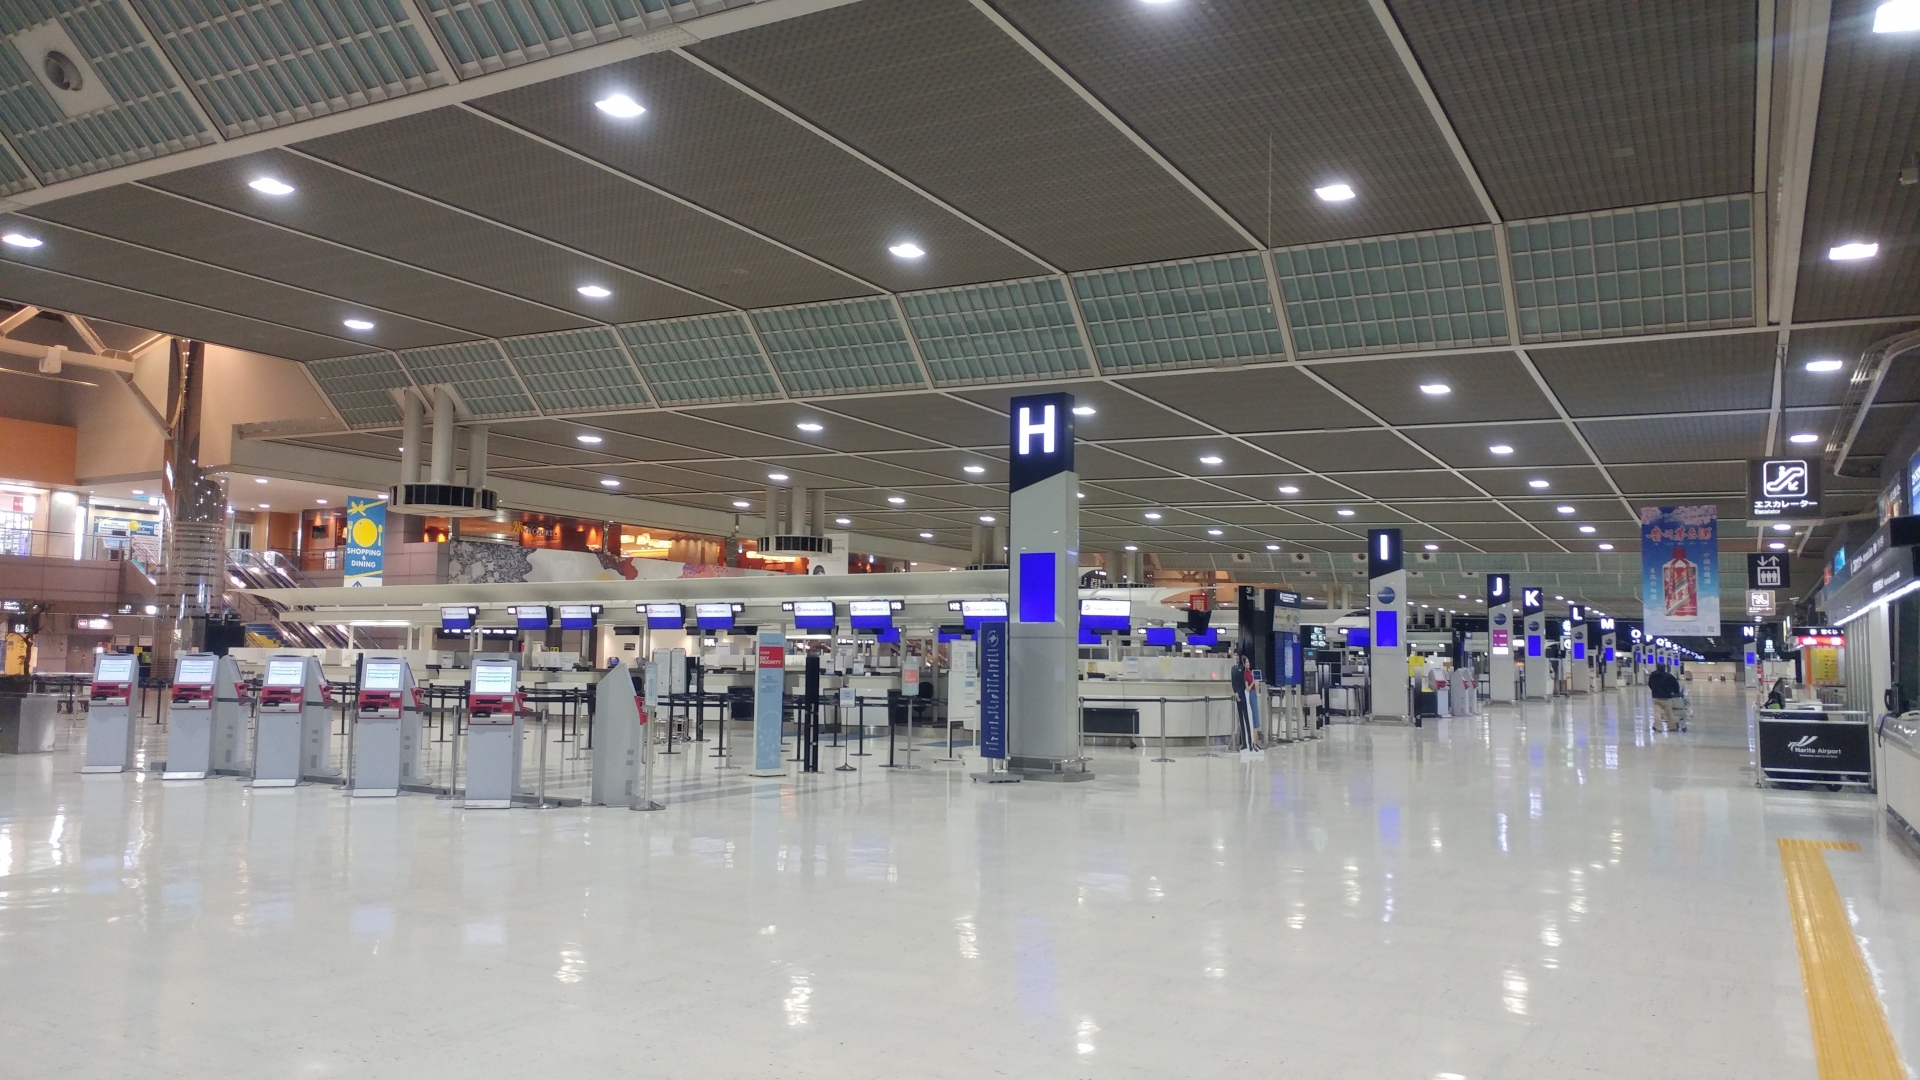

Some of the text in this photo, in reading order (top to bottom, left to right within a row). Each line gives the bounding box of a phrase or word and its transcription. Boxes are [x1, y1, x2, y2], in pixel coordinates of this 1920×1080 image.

[1019, 405, 1055, 455] H
[1754, 499, 1818, 508] エスカレーター
[347, 547, 381, 556] SHOPPING
[1380, 534, 1388, 560] I
[351, 560, 376, 568] DINING
[1493, 577, 1502, 596] J
[1525, 590, 1539, 607] K
[891, 602, 901, 610] H3
[950, 602, 960, 610] H2
[1573, 607, 1583, 620] L
[1601, 618, 1615, 630] M
[1631, 629, 1642, 639] O
[1744, 626, 1754, 636] N
[1645, 634, 1653, 642] P
[1817, 747, 1842, 755] Airport
